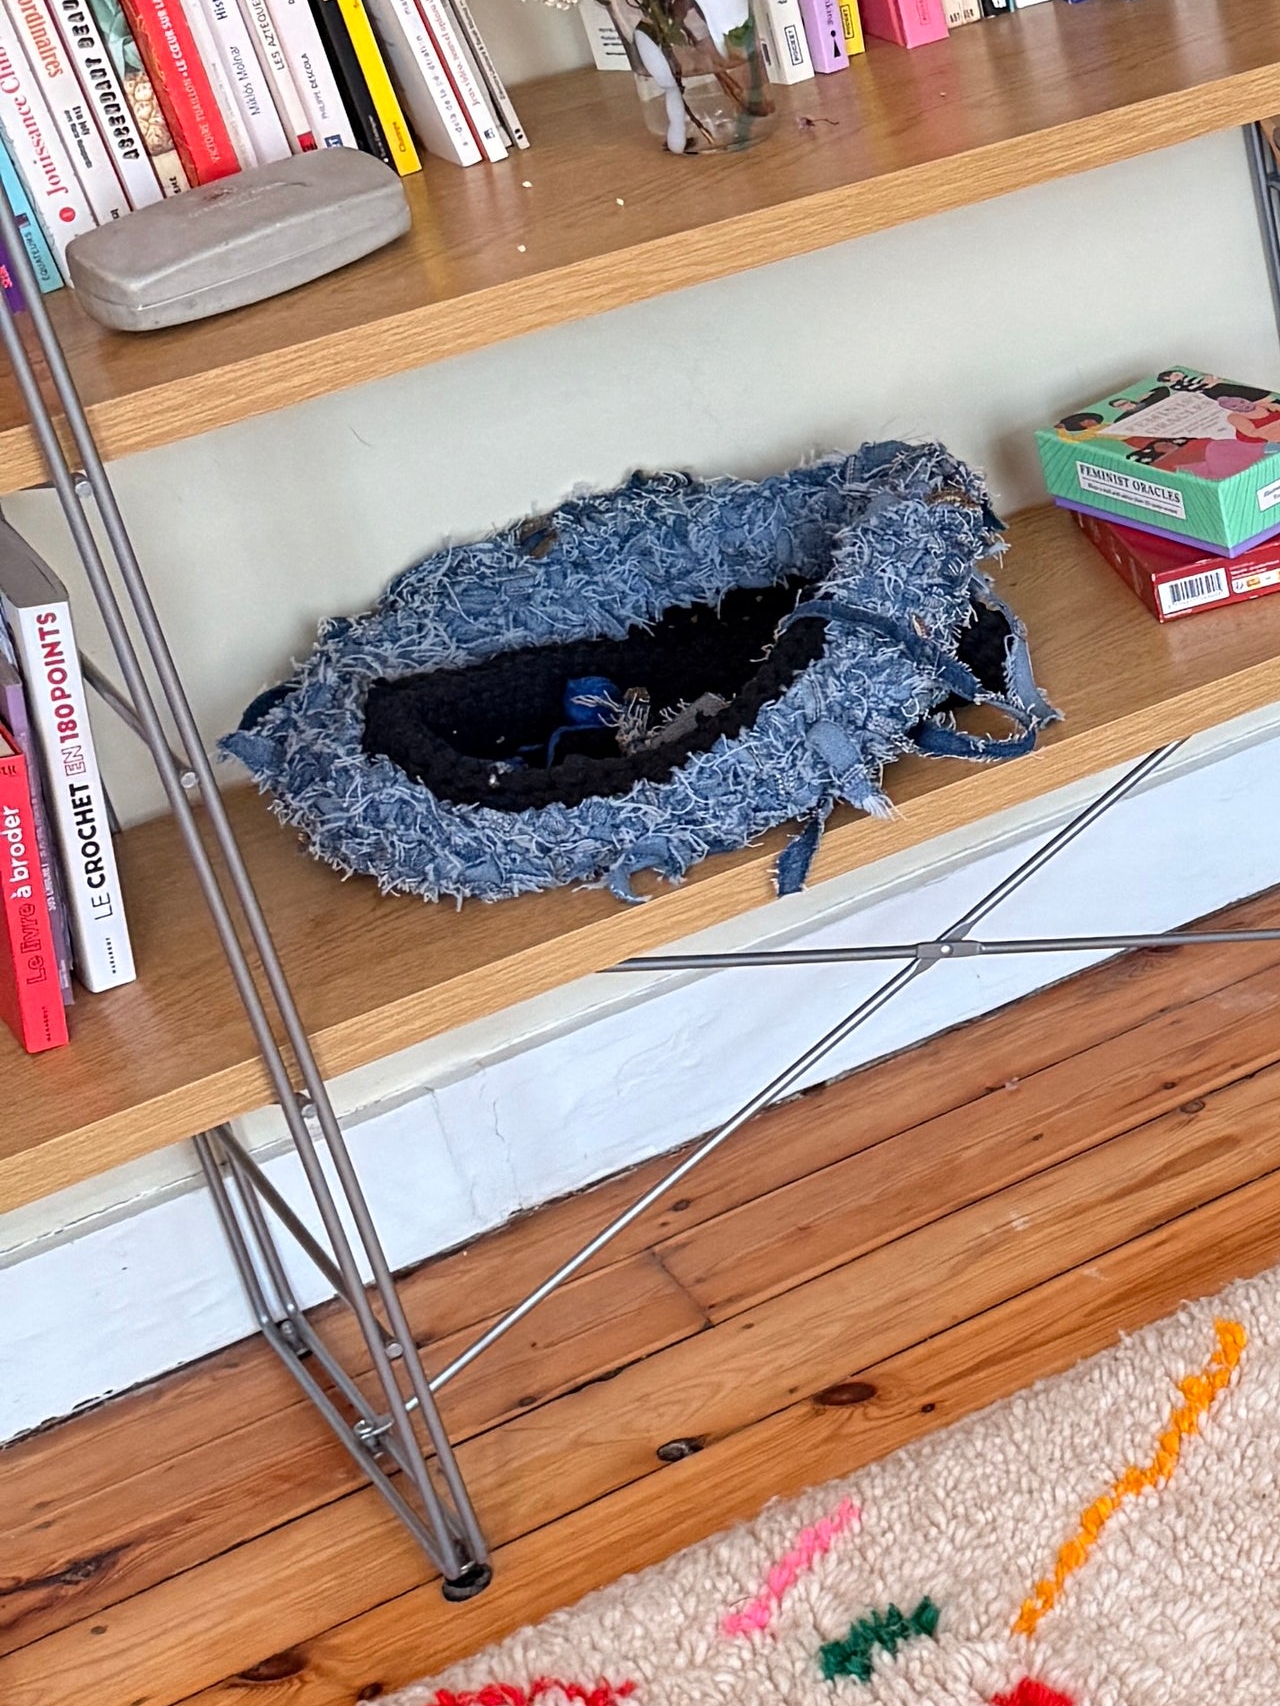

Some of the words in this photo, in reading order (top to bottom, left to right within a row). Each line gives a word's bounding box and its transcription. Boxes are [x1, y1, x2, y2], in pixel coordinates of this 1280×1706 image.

[153, 5, 172, 29] SUR
[840, 6, 852, 36] POCKET
[268, 48, 286, 72] LES
[786, 27, 800, 62] POCKET
[172, 57, 188, 73] LE
[298, 51, 319, 90] DESCOLA
[84, 55, 140, 161] ASCENDANT
[14, 91, 69, 198] Jouissance
[1079, 464, 1130, 488] FEMINIST
[1133, 480, 1181, 504] ORACLES
[35, 611, 71, 702] POINTS
[58, 703, 81, 746] 180
[61, 745, 87, 777] EN
[0, 805, 30, 883] broder
[69, 783, 107, 889] CROCHET
[10, 868, 32, 899] à
[91, 892, 113, 921] LE
[20, 903, 42, 955] livre
[27, 955, 48, 985] Le
